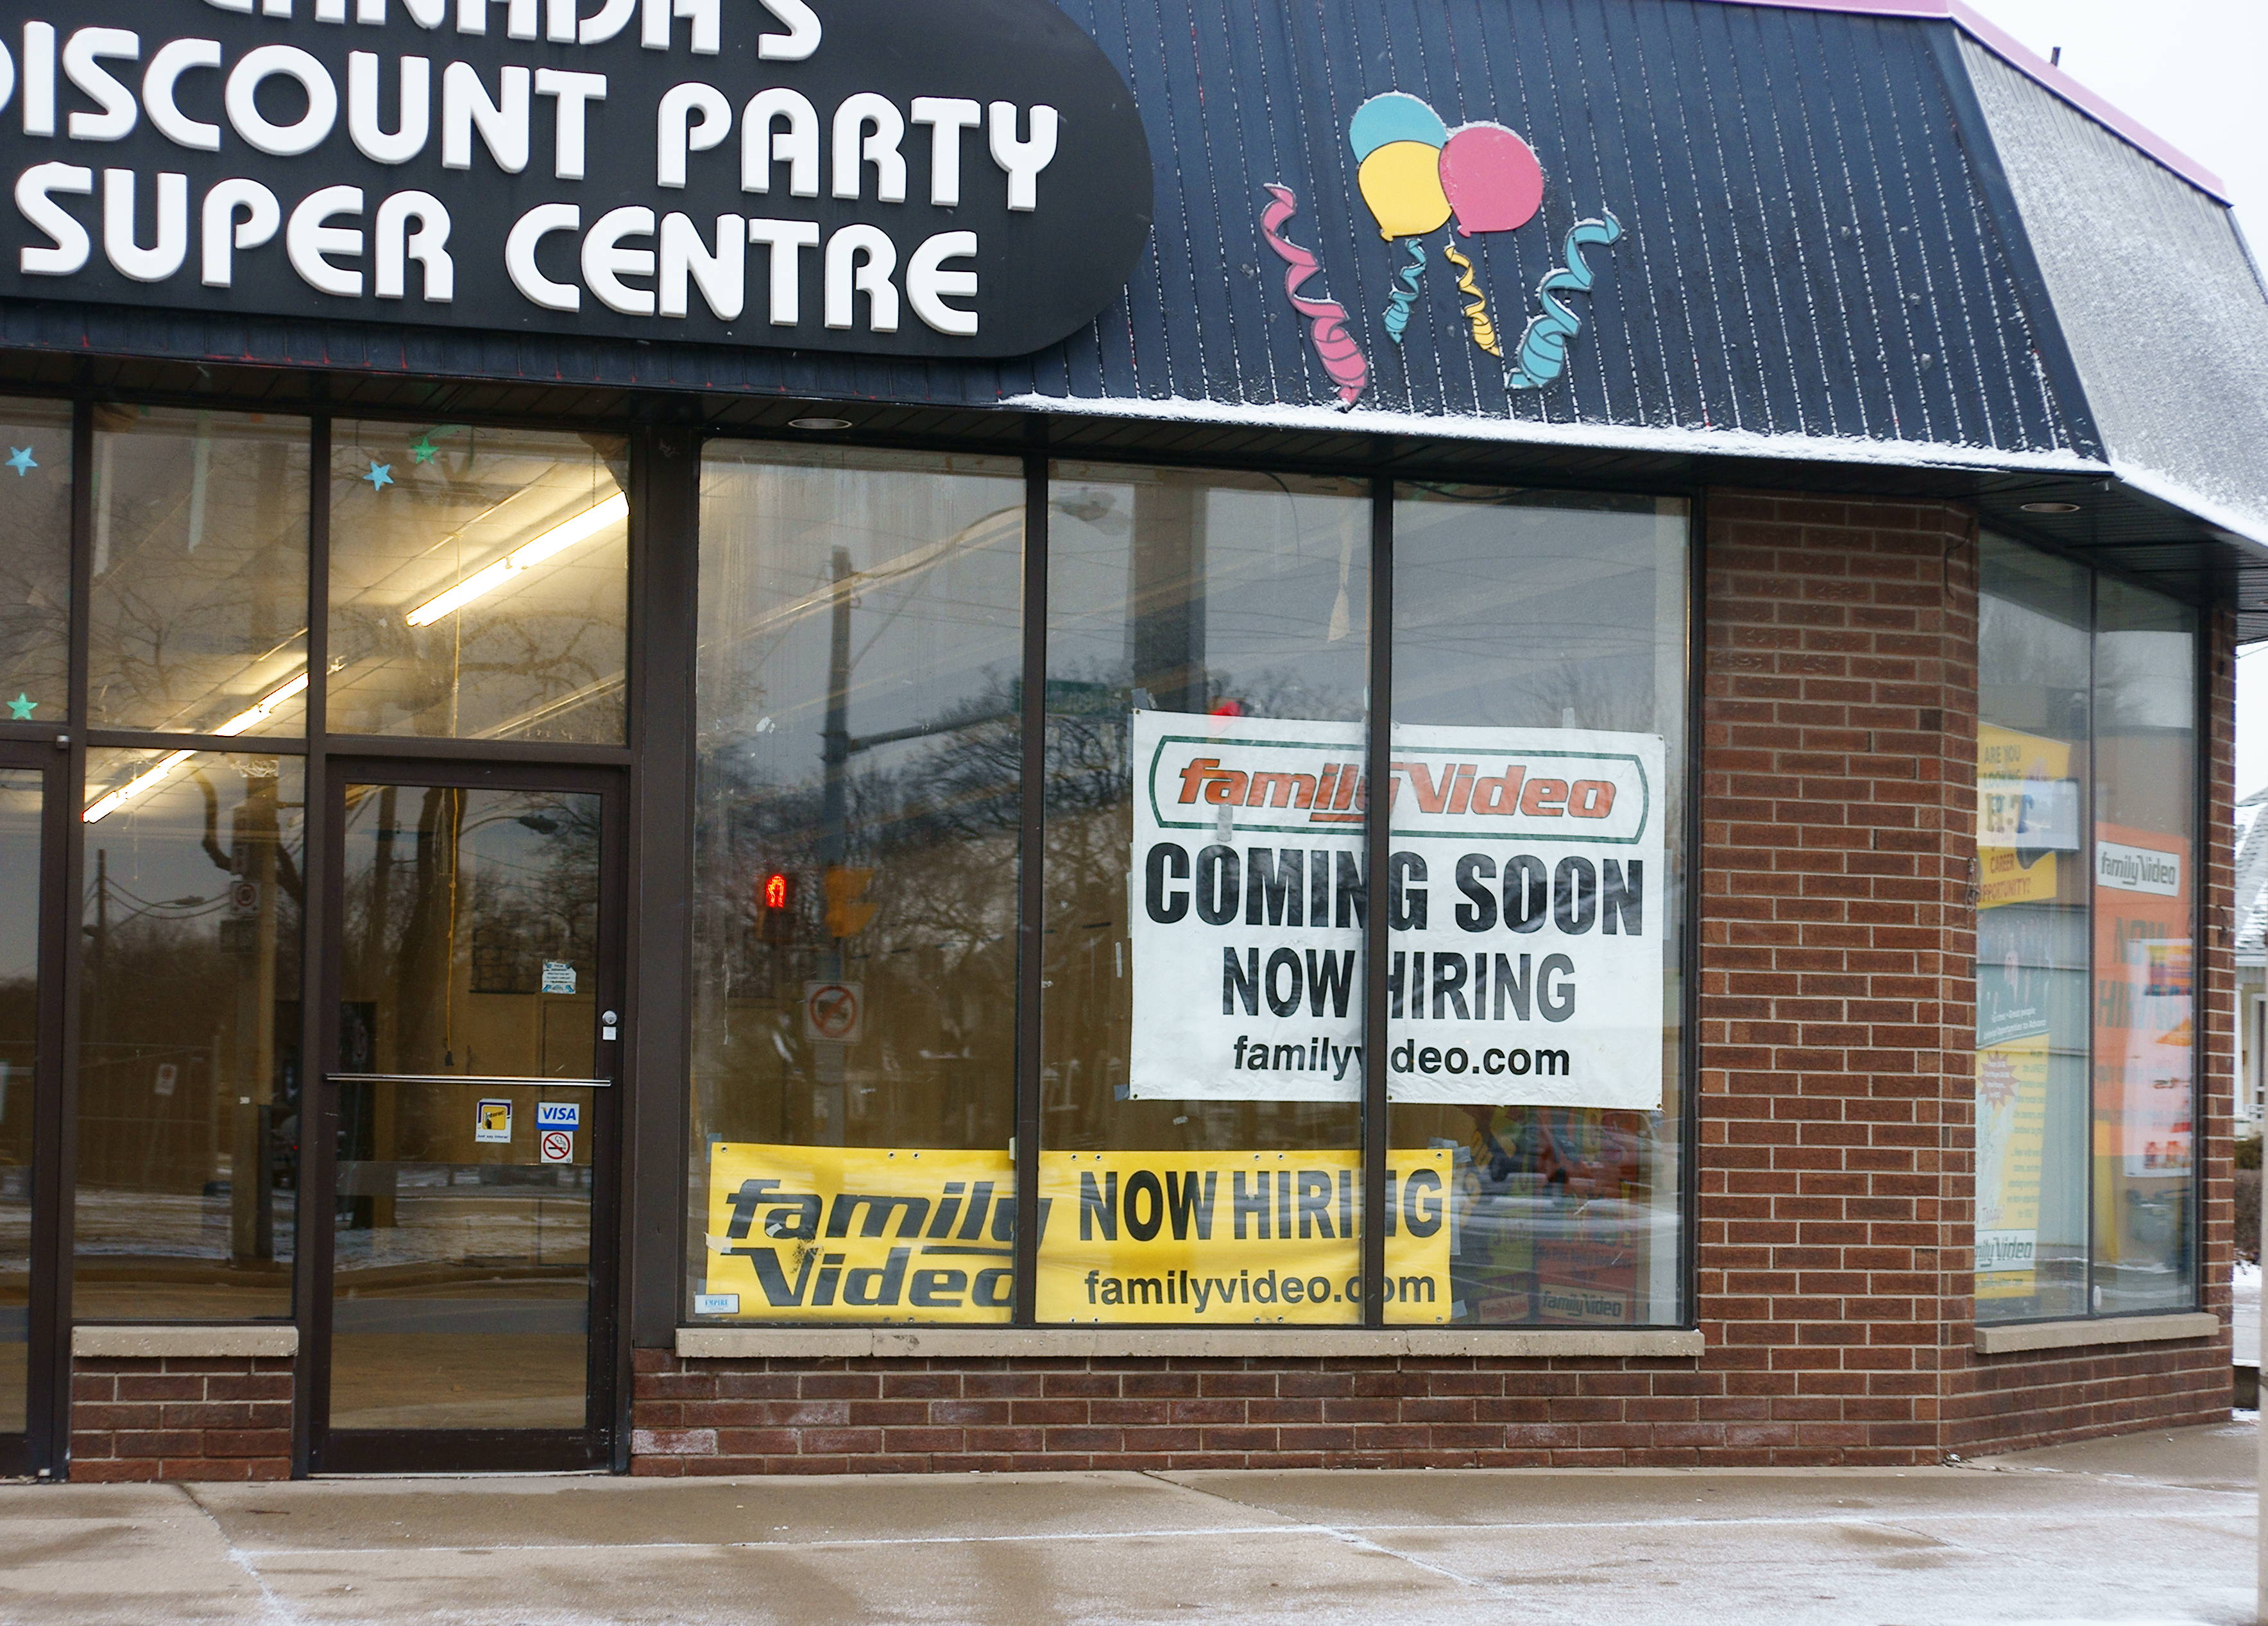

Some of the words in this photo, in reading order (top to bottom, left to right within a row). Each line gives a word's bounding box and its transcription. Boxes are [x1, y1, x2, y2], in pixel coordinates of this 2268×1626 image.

[0, 21, 607, 180] ISCOUNT
[657, 81, 1059, 211] PARTY
[15, 162, 453, 302] SUPER
[506, 203, 978, 336] CENTRE
[1146, 843, 1428, 932] COMING
[1455, 853, 1643, 936] SOON
[1223, 946, 1355, 1018] NOW
[1234, 1036, 1570, 1081] familydeo.com
[541, 1107, 576, 1120] VISA
[1080, 1170, 1218, 1242] NOW
[720, 1247, 1016, 1307] Video
